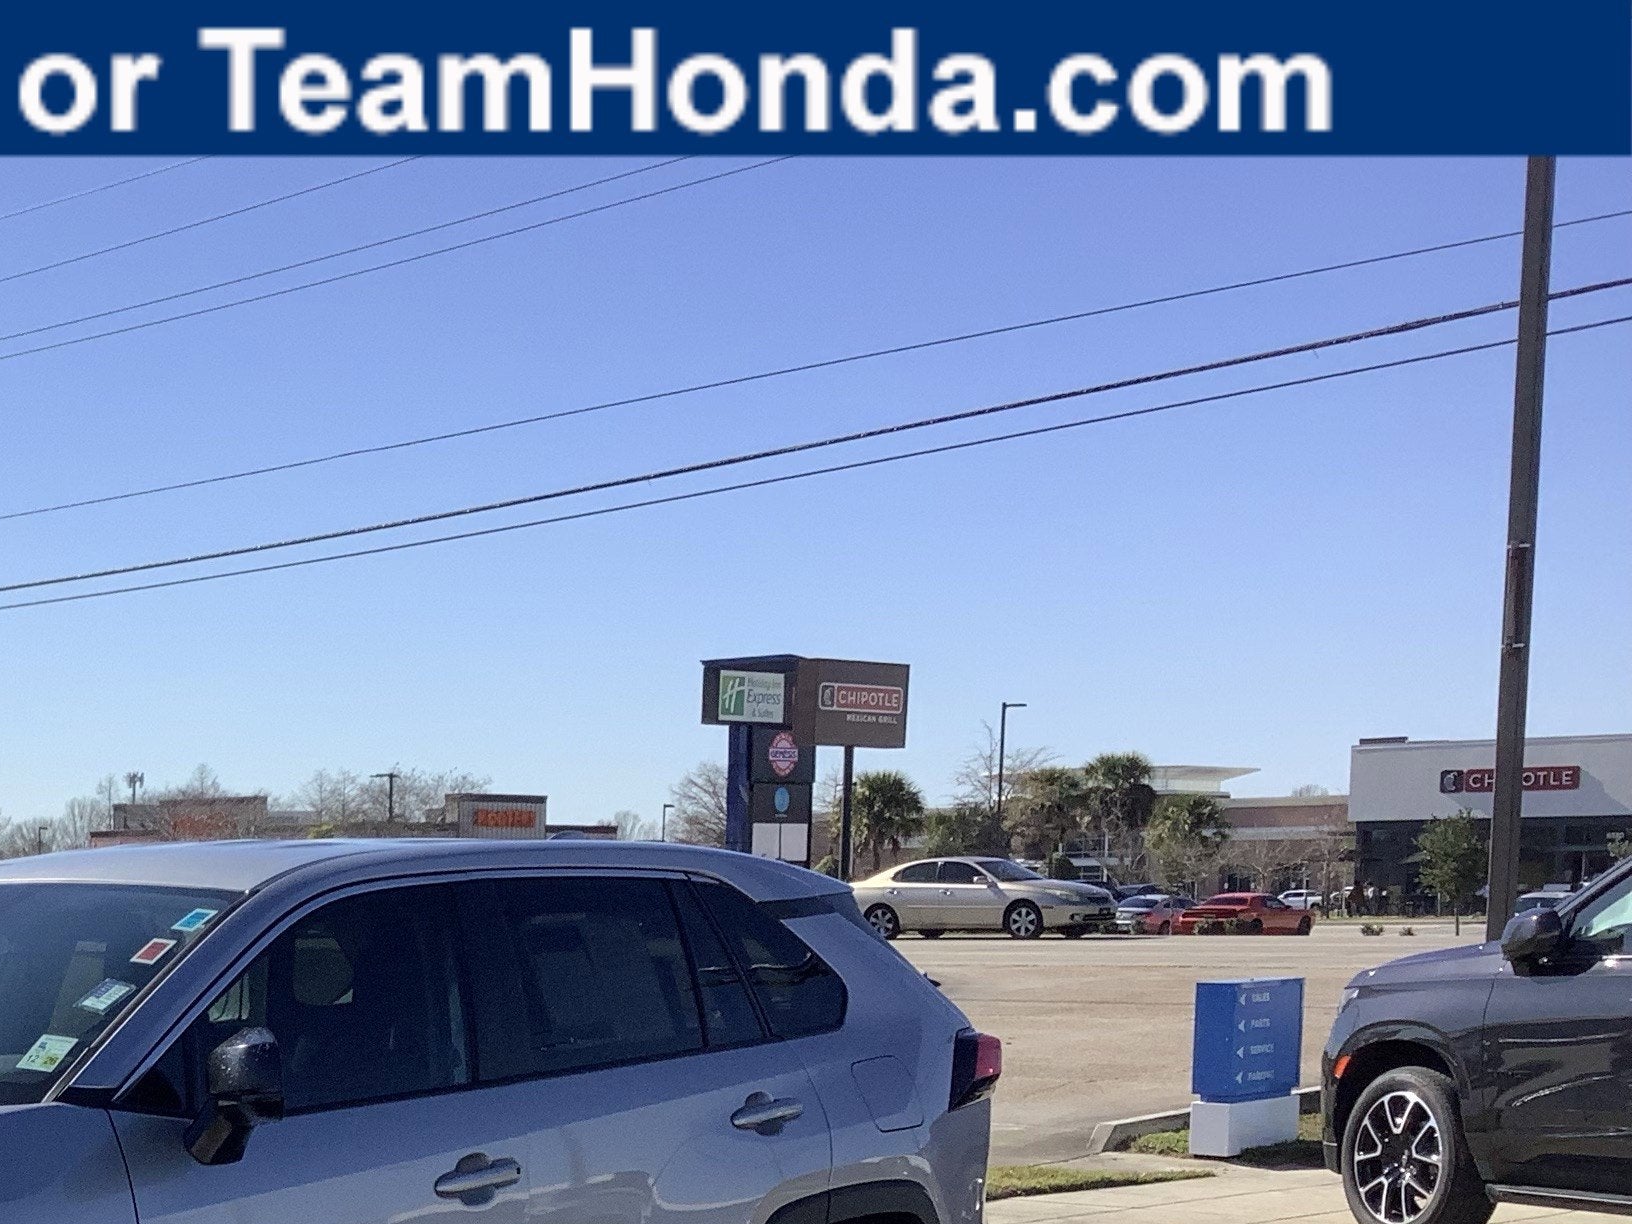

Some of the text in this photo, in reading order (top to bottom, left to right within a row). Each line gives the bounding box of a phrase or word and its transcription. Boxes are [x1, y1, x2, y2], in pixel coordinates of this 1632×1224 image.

[747, 689, 781, 706] Express
[838, 690, 899, 707] CHIPOTLE
[1468, 770, 1574, 788] CHOTLE
